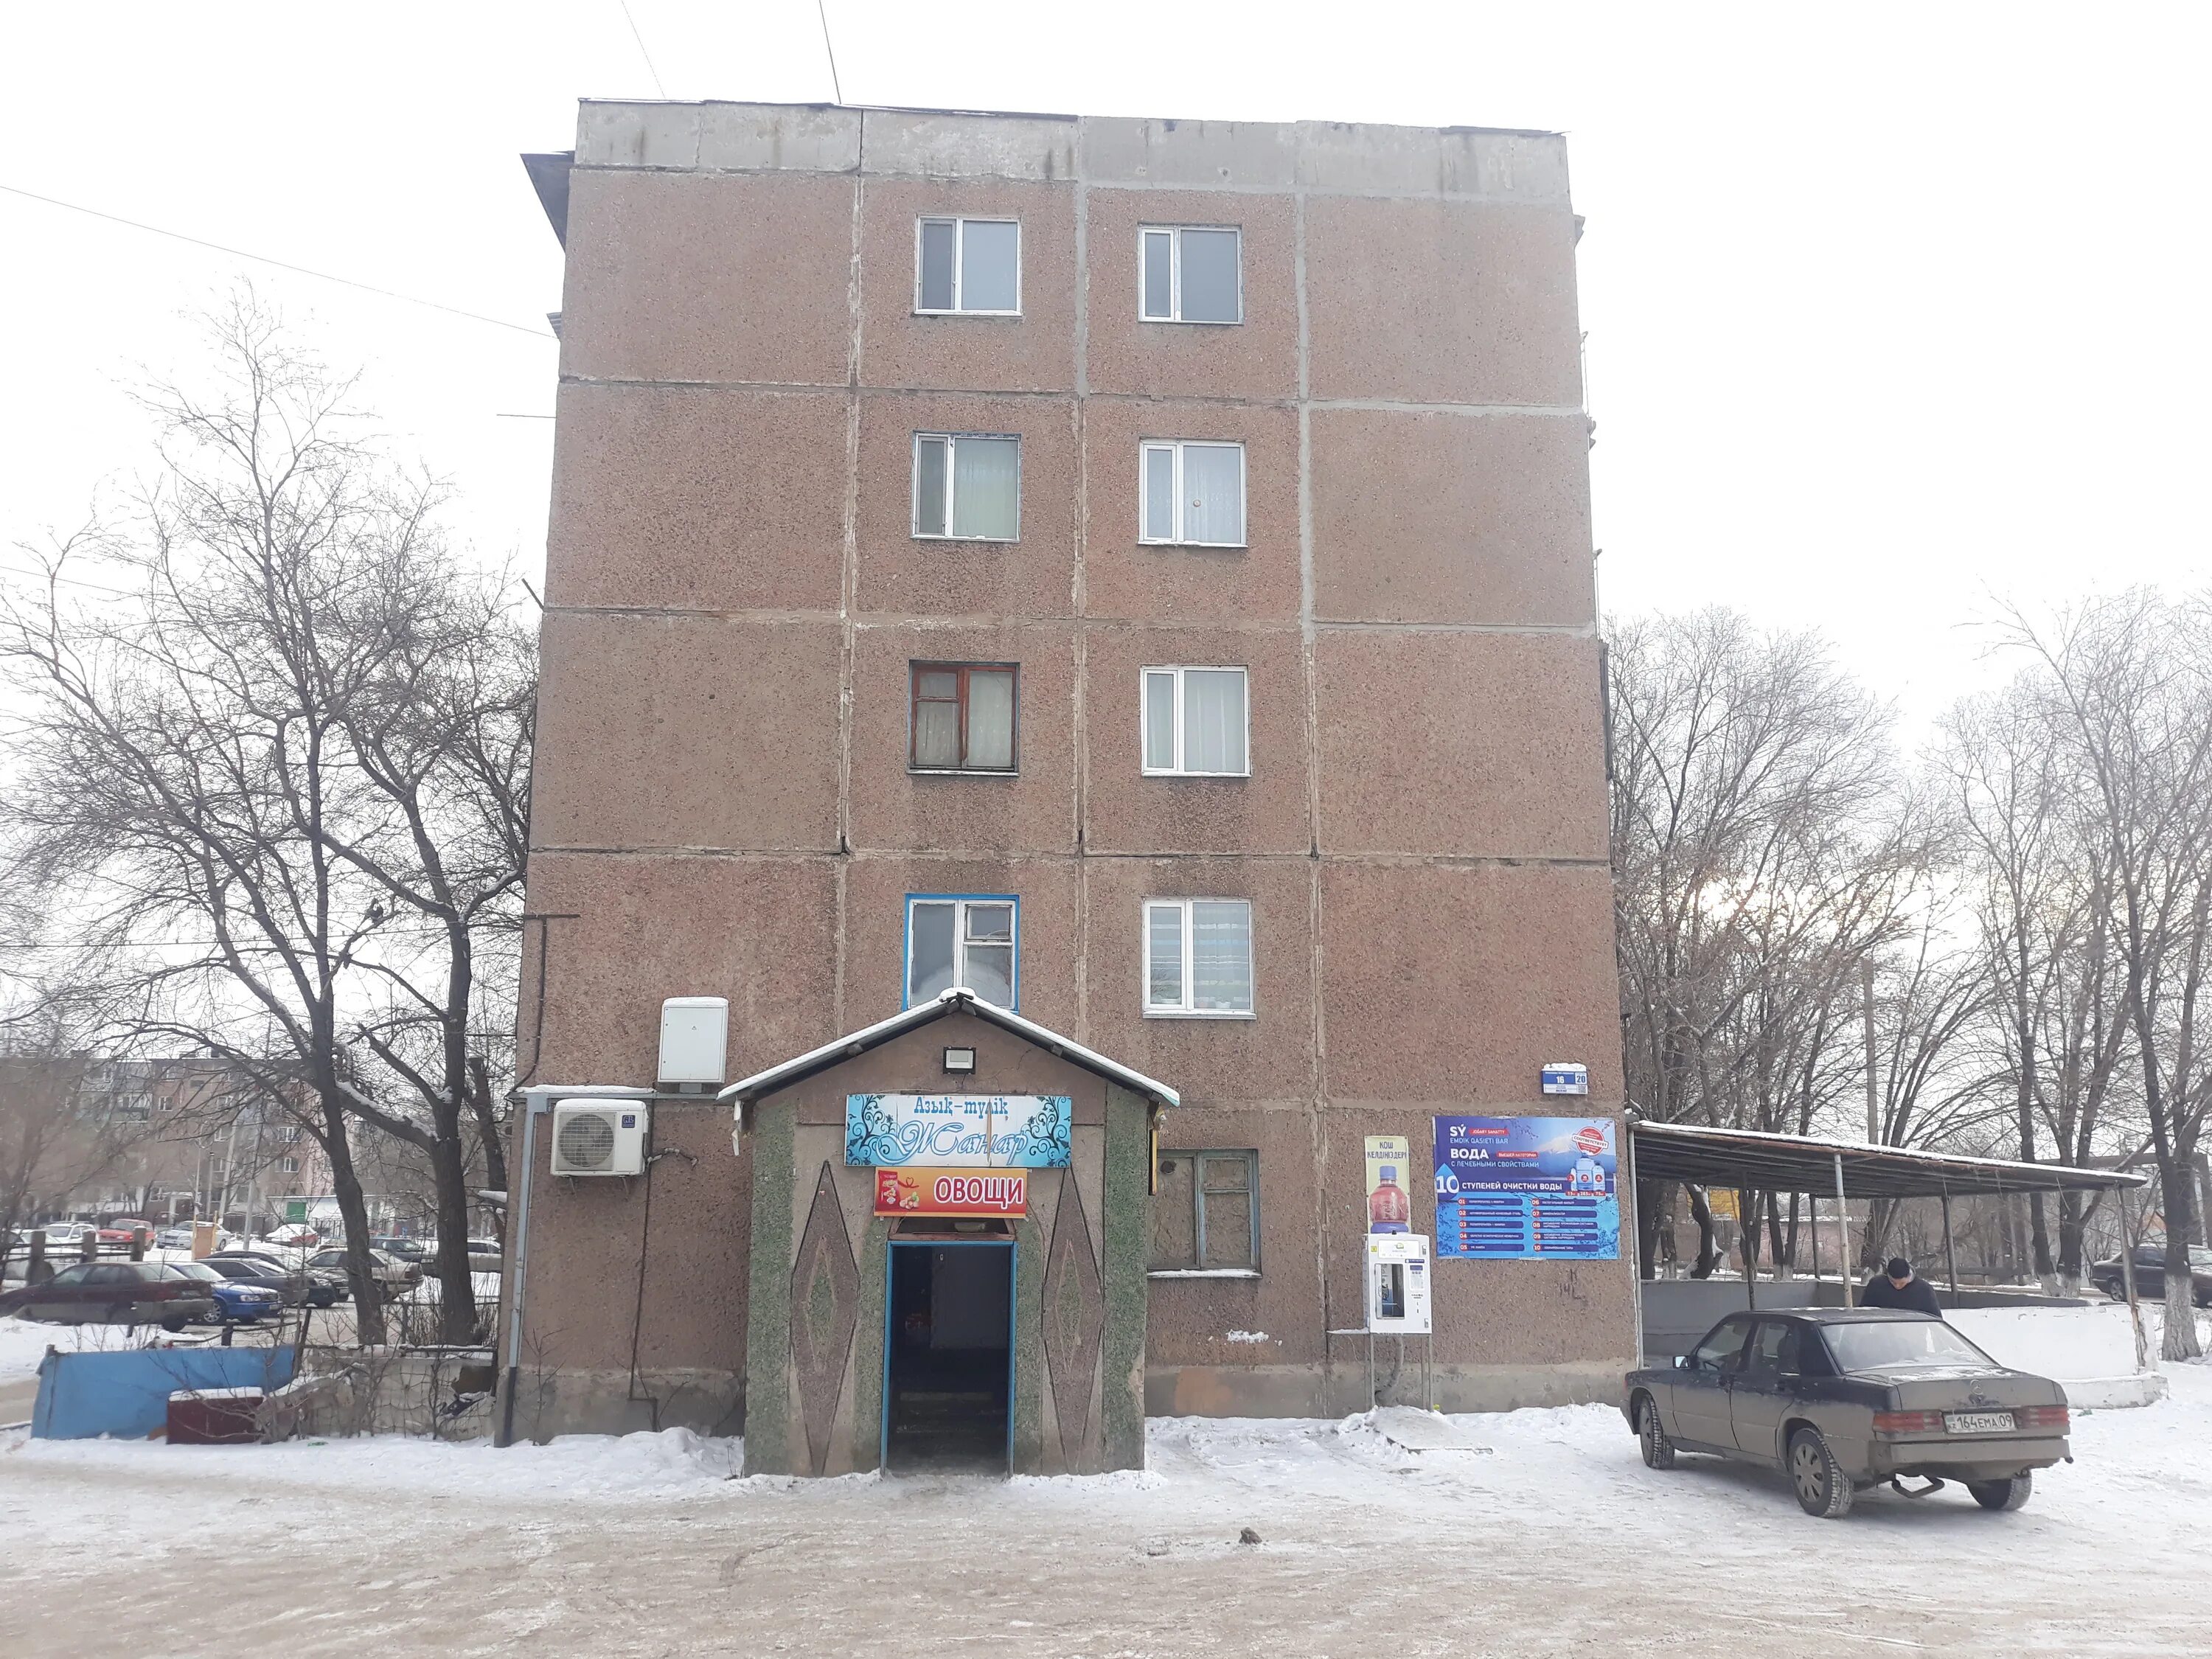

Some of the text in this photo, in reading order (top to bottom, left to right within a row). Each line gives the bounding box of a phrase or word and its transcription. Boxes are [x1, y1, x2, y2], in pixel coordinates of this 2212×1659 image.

[1556, 1075, 1565, 1084] 16
[1576, 1075, 1586, 1083] 20
[875, 1120, 1028, 1166] Жанар
[1573, 1135, 1607, 1147] СООТВЕТСТВУЕТ
[1450, 1148, 1489, 1160] ВОДА
[1436, 1175, 1562, 1194] 10 СТУПЕНЕЙ ОЧИСТКИ ВОДЫ
[934, 1176, 1024, 1210] ОВОЩИ
[1956, 1416, 1998, 1428] 164EMA
[1998, 1414, 2012, 1427] 09
